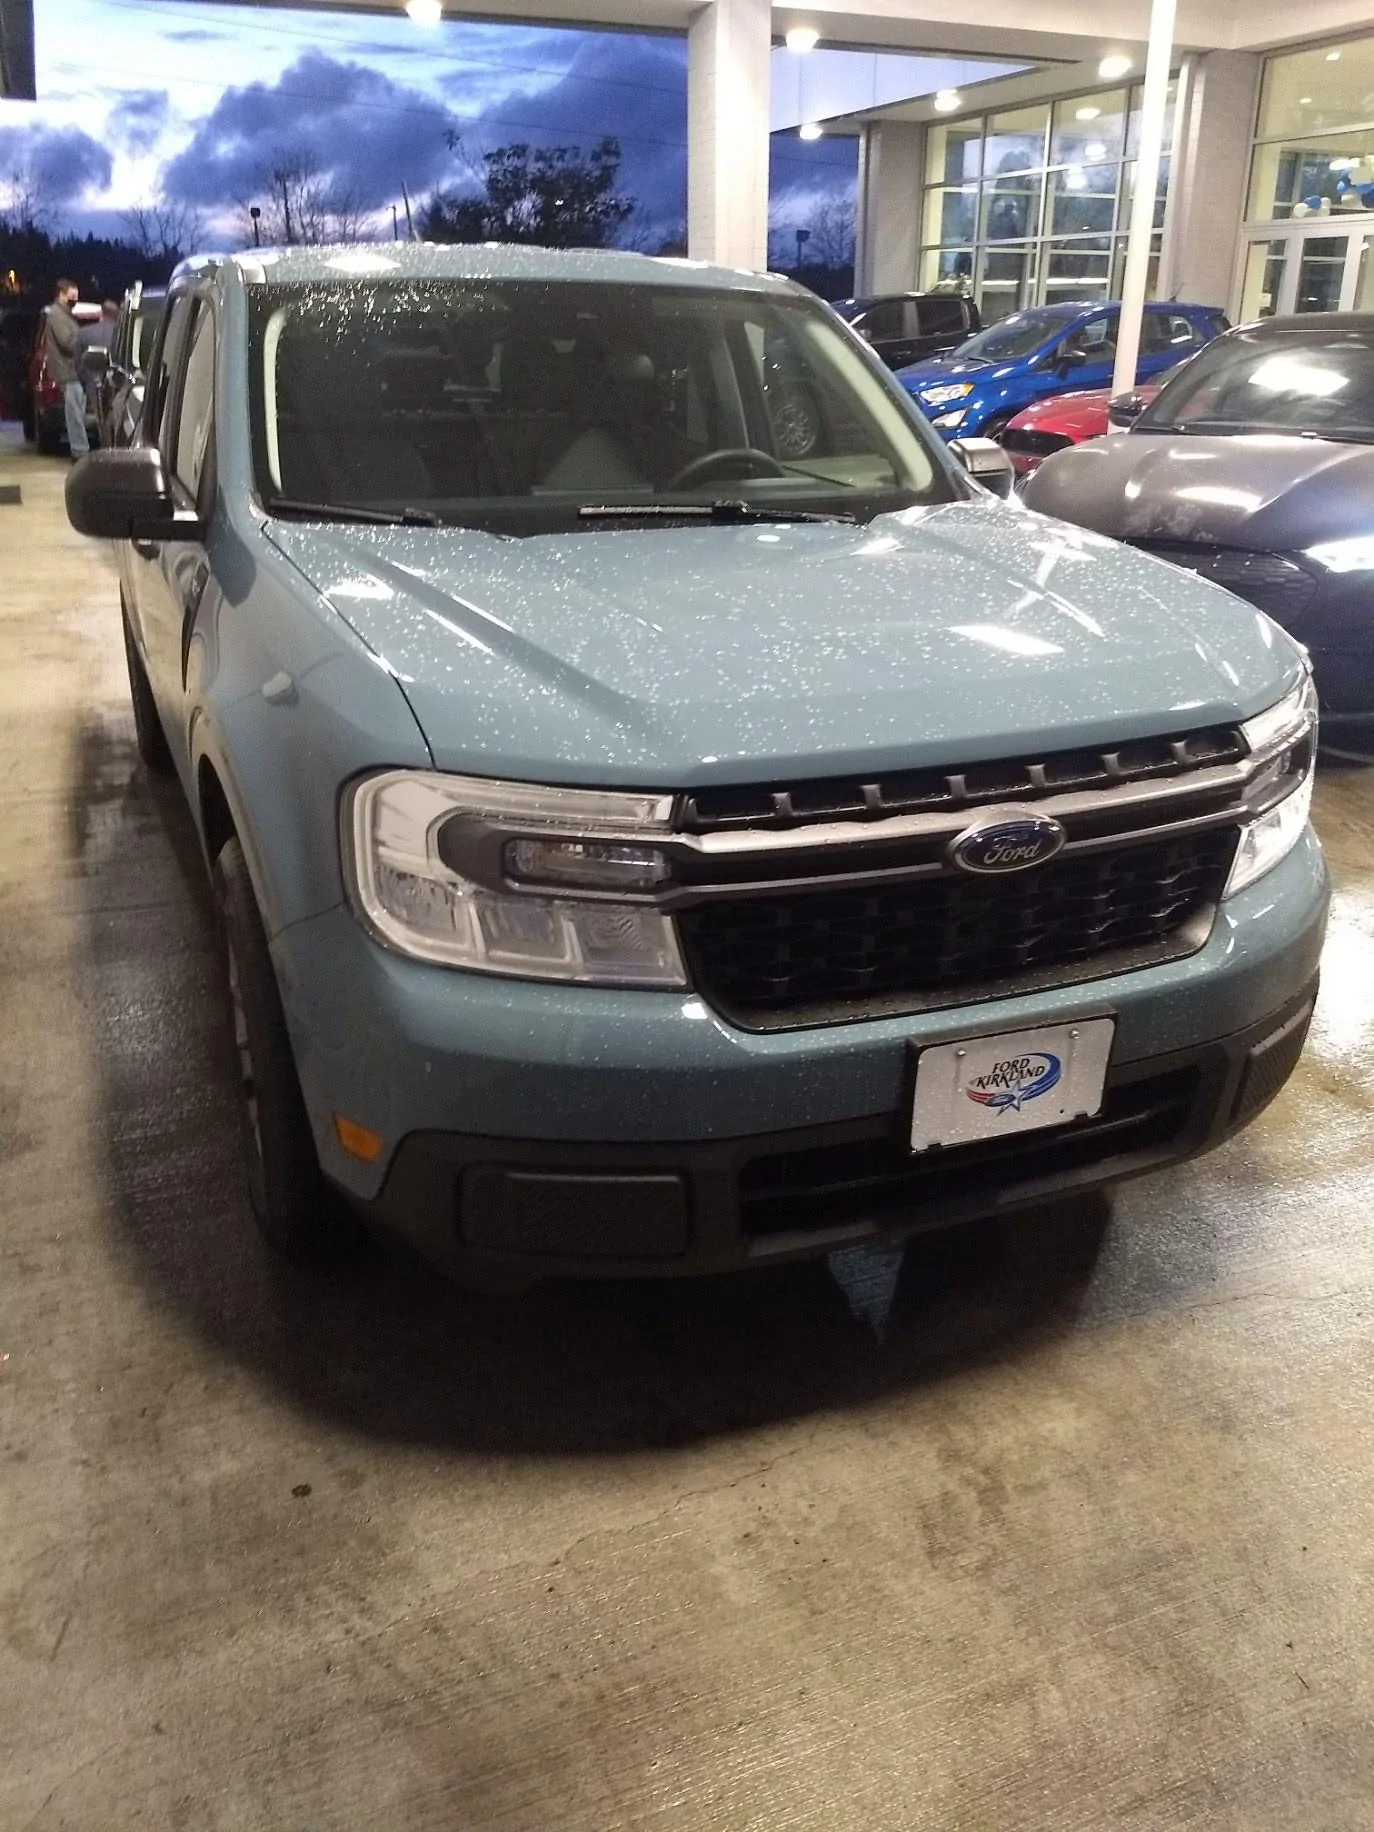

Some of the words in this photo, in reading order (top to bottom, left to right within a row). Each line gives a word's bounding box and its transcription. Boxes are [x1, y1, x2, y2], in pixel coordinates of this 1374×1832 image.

[983, 835, 1041, 864] Ford
[976, 1066, 1045, 1089] KIRKLAND
[992, 1058, 1030, 1074] FORD
